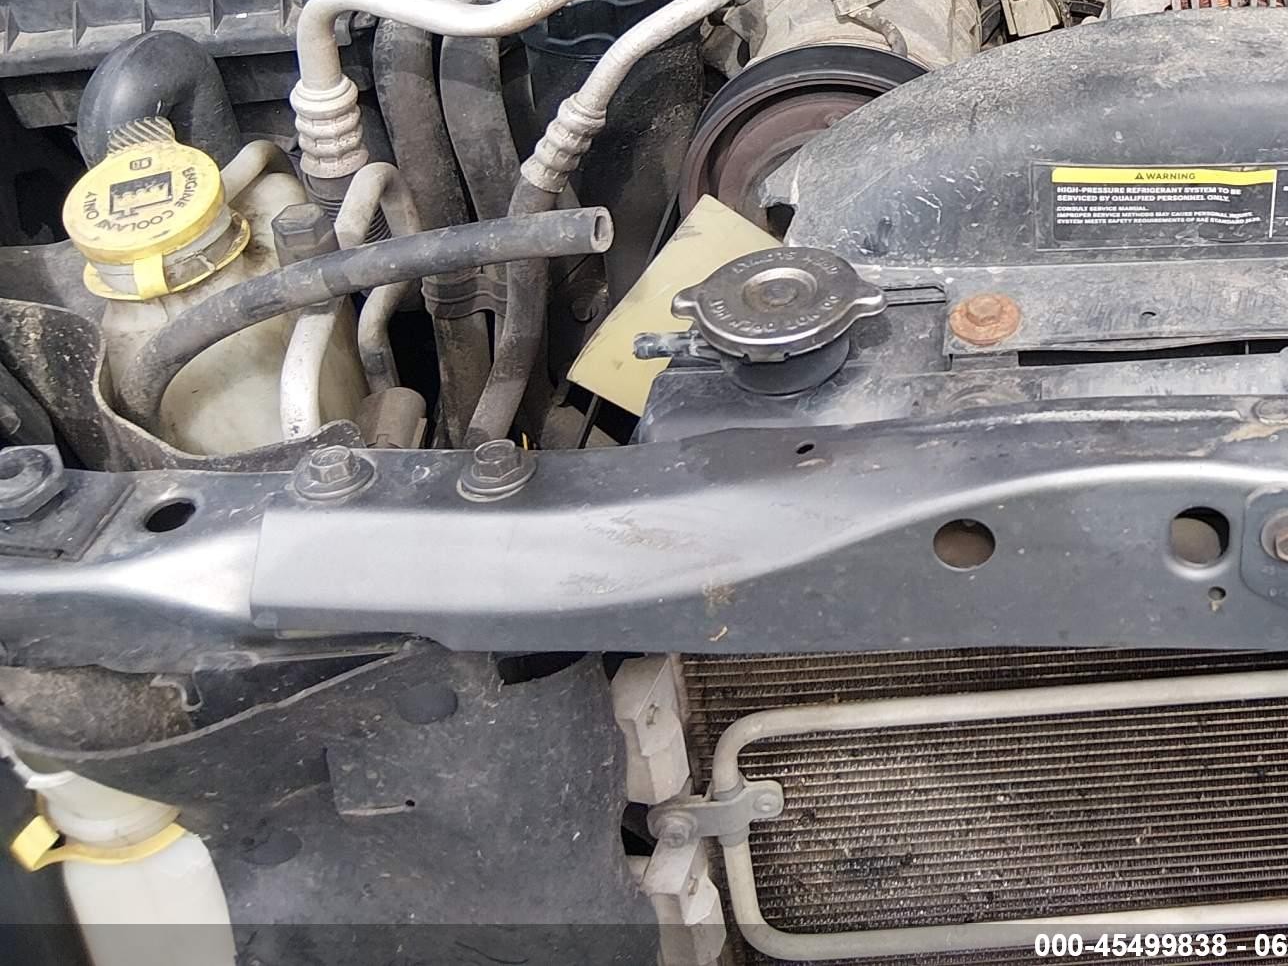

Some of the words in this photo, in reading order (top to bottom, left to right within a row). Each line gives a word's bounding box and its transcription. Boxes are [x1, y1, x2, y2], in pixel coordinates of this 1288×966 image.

[1146, 172, 1196, 180] WARNING
[174, 166, 198, 209] ENGINE
[1056, 186, 1125, 194] HIGH-PRESSURE
[1126, 186, 1183, 194] REFRIGERANT
[1184, 186, 1217, 194] SYSTEM
[83, 191, 100, 221] ONLY
